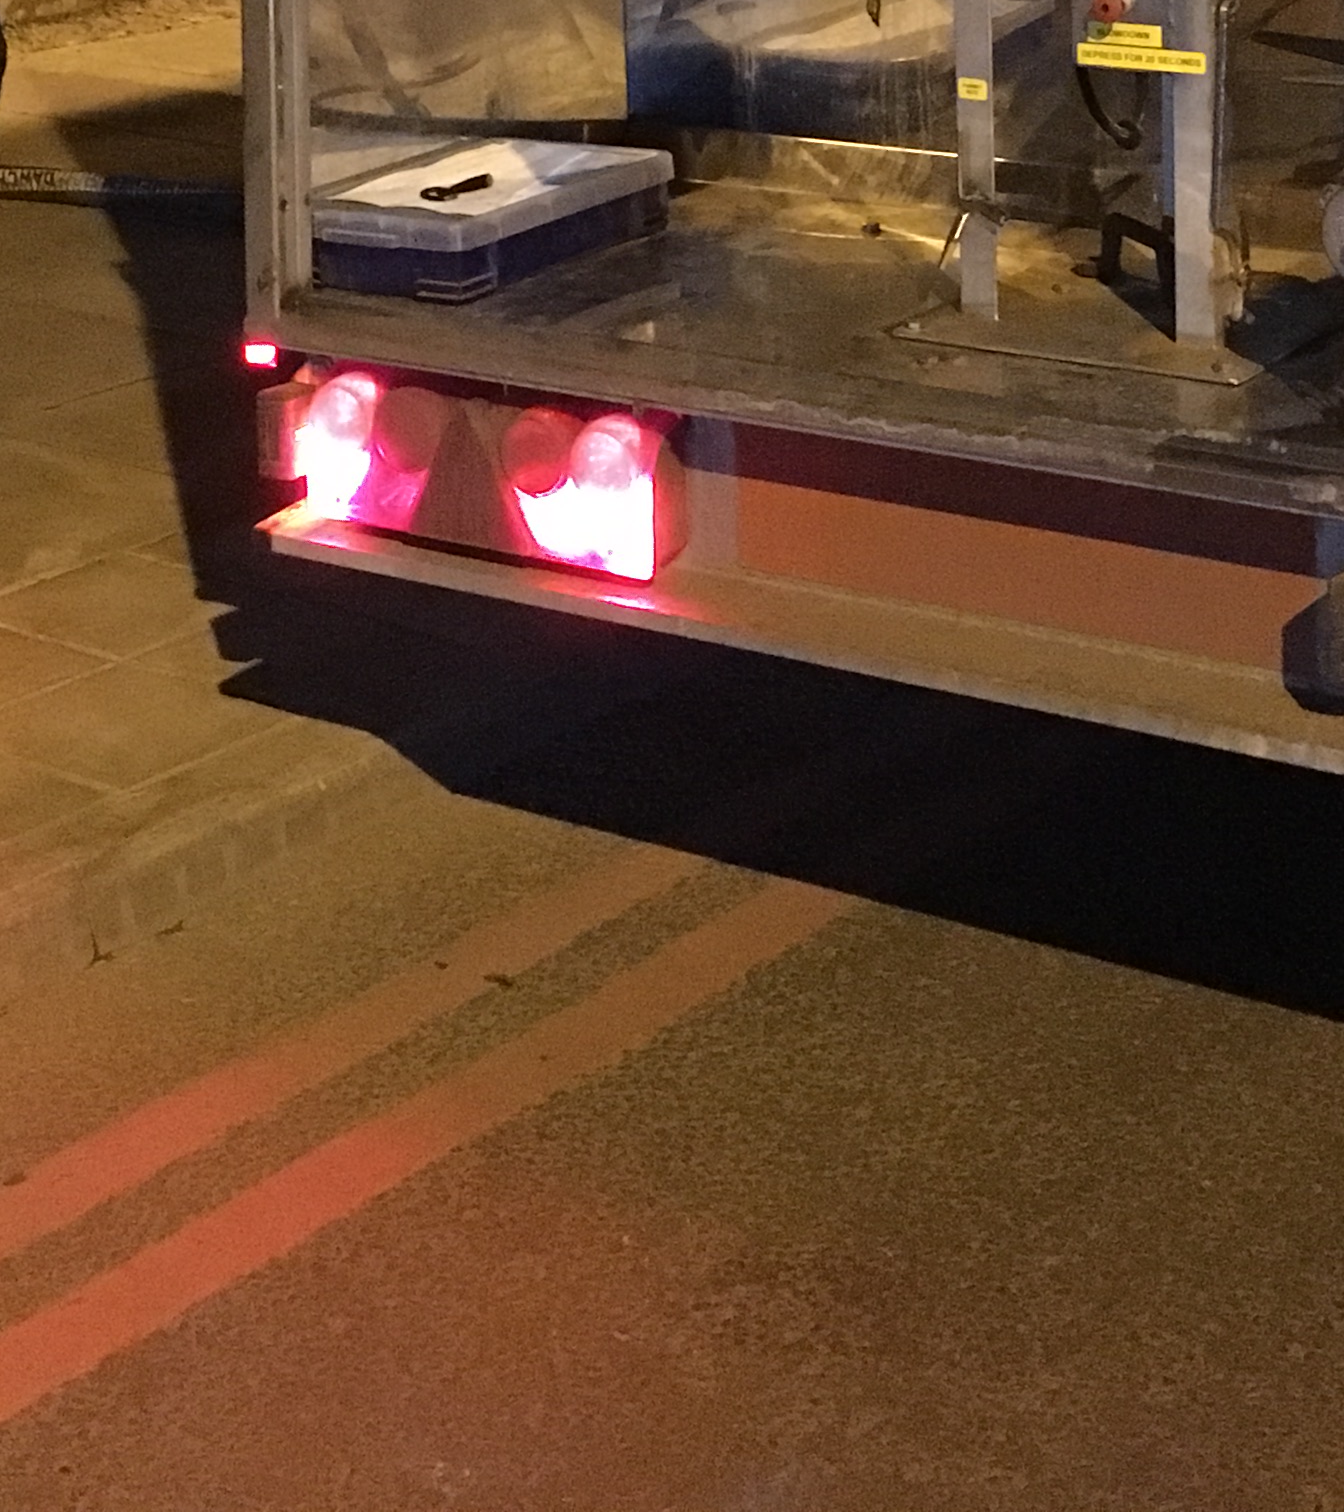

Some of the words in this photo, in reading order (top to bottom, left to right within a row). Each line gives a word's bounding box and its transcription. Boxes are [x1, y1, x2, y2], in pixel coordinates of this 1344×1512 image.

[1080, 48, 1123, 61] DEPRESS
[1124, 52, 1143, 63] FOR
[1158, 55, 1202, 68] SECONDS
